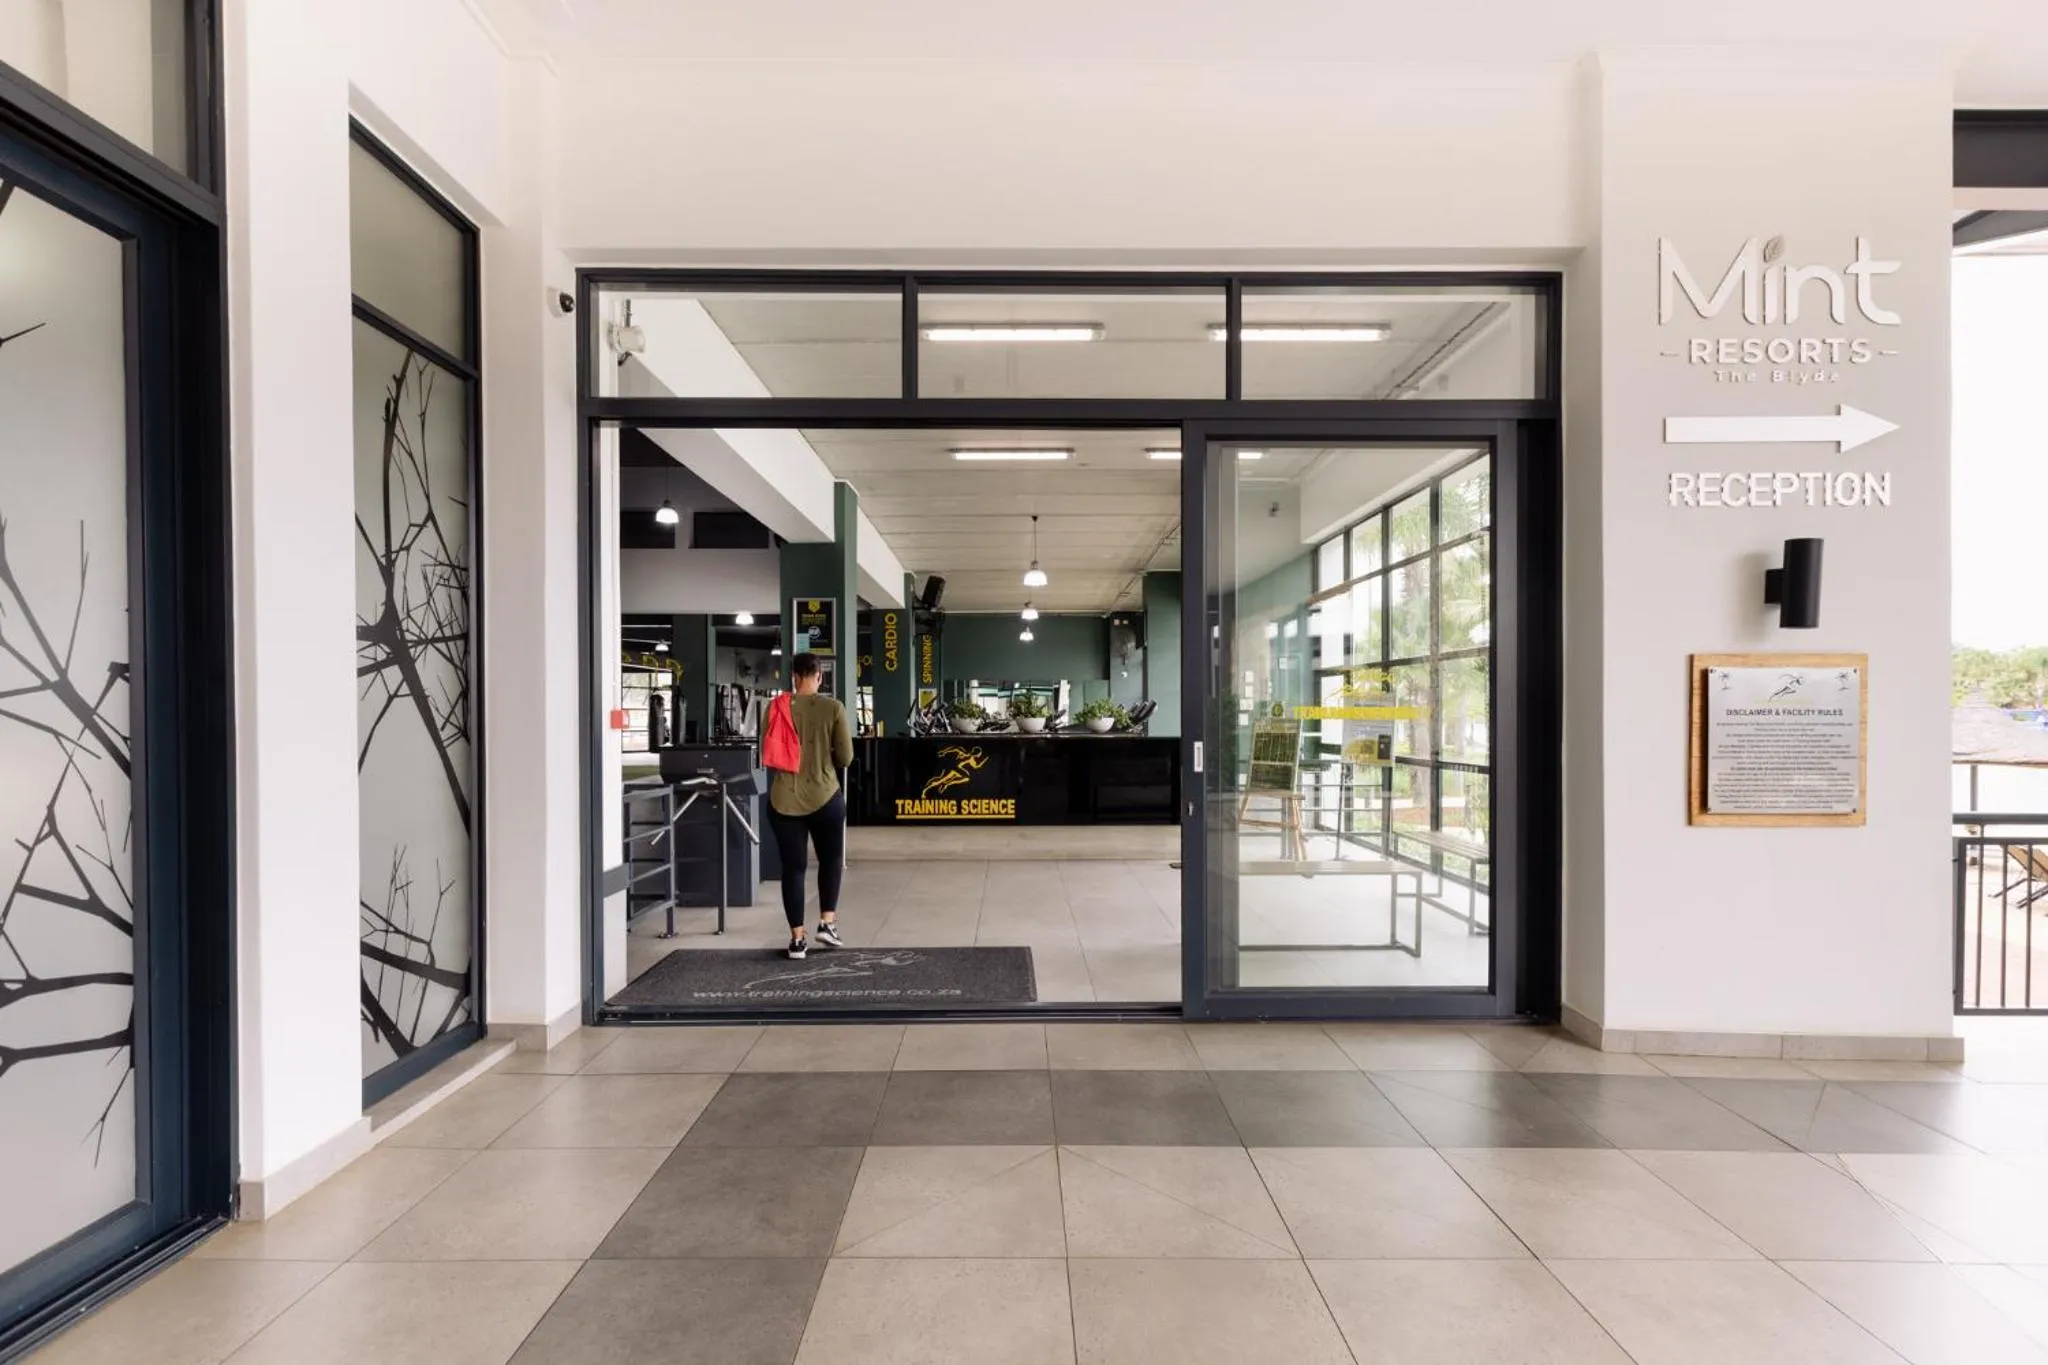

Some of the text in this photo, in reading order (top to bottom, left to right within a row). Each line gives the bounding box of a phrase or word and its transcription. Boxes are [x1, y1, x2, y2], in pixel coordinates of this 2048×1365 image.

[1658, 234, 1902, 325] Mint
[1689, 338, 1872, 364] RESORTS
[1715, 370, 1841, 386] The Blyde
[1669, 472, 1891, 507] RECEPTION
[885, 613, 897, 671] CARDIO
[922, 634, 933, 684] SPINNING
[1725, 708, 1772, 717] DISCLAIMER
[1783, 708, 1815, 717] FACILITY
[1818, 708, 1844, 717] RULES
[895, 799, 1016, 814] TRAINING SCIENCE
